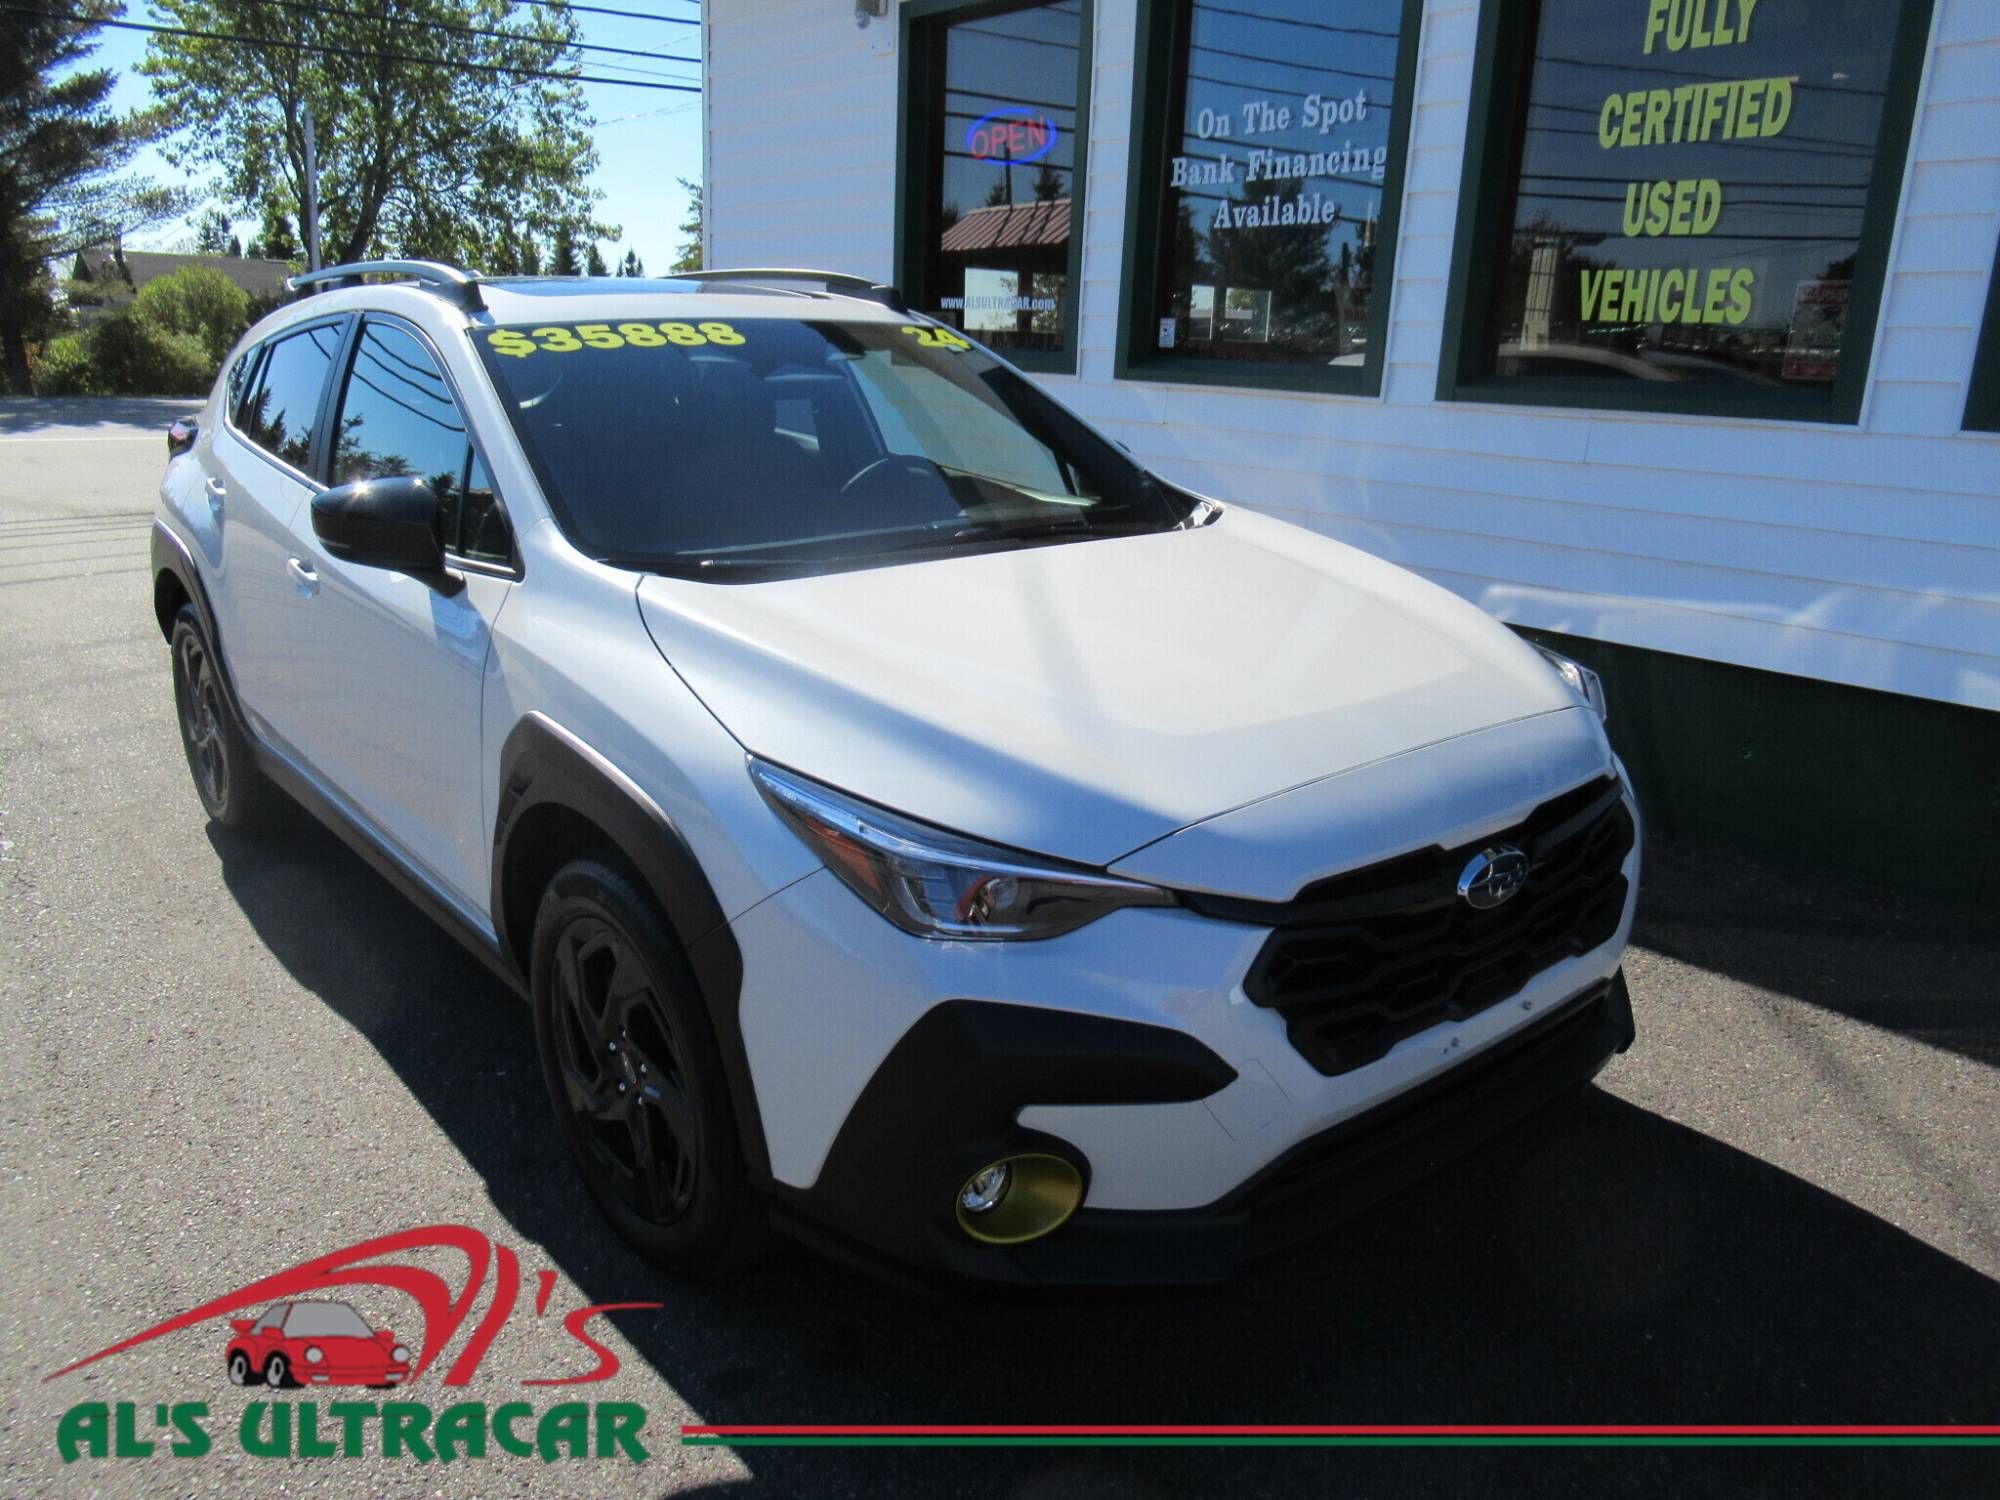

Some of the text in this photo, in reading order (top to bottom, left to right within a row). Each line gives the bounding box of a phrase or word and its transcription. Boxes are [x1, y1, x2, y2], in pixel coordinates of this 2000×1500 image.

[1643, 0, 1758, 54] FULLY
[972, 114, 1046, 160] OPEN
[1197, 89, 1369, 139] On The Spot
[1599, 77, 1793, 149] CERTIFIED
[1170, 140, 1388, 187] Bank Financing
[1213, 193, 1336, 230] Available
[1622, 178, 1722, 237] USED
[1580, 268, 1755, 325] VEHICLES
[487, 321, 746, 359] $35888
[901, 326, 973, 352] 24
